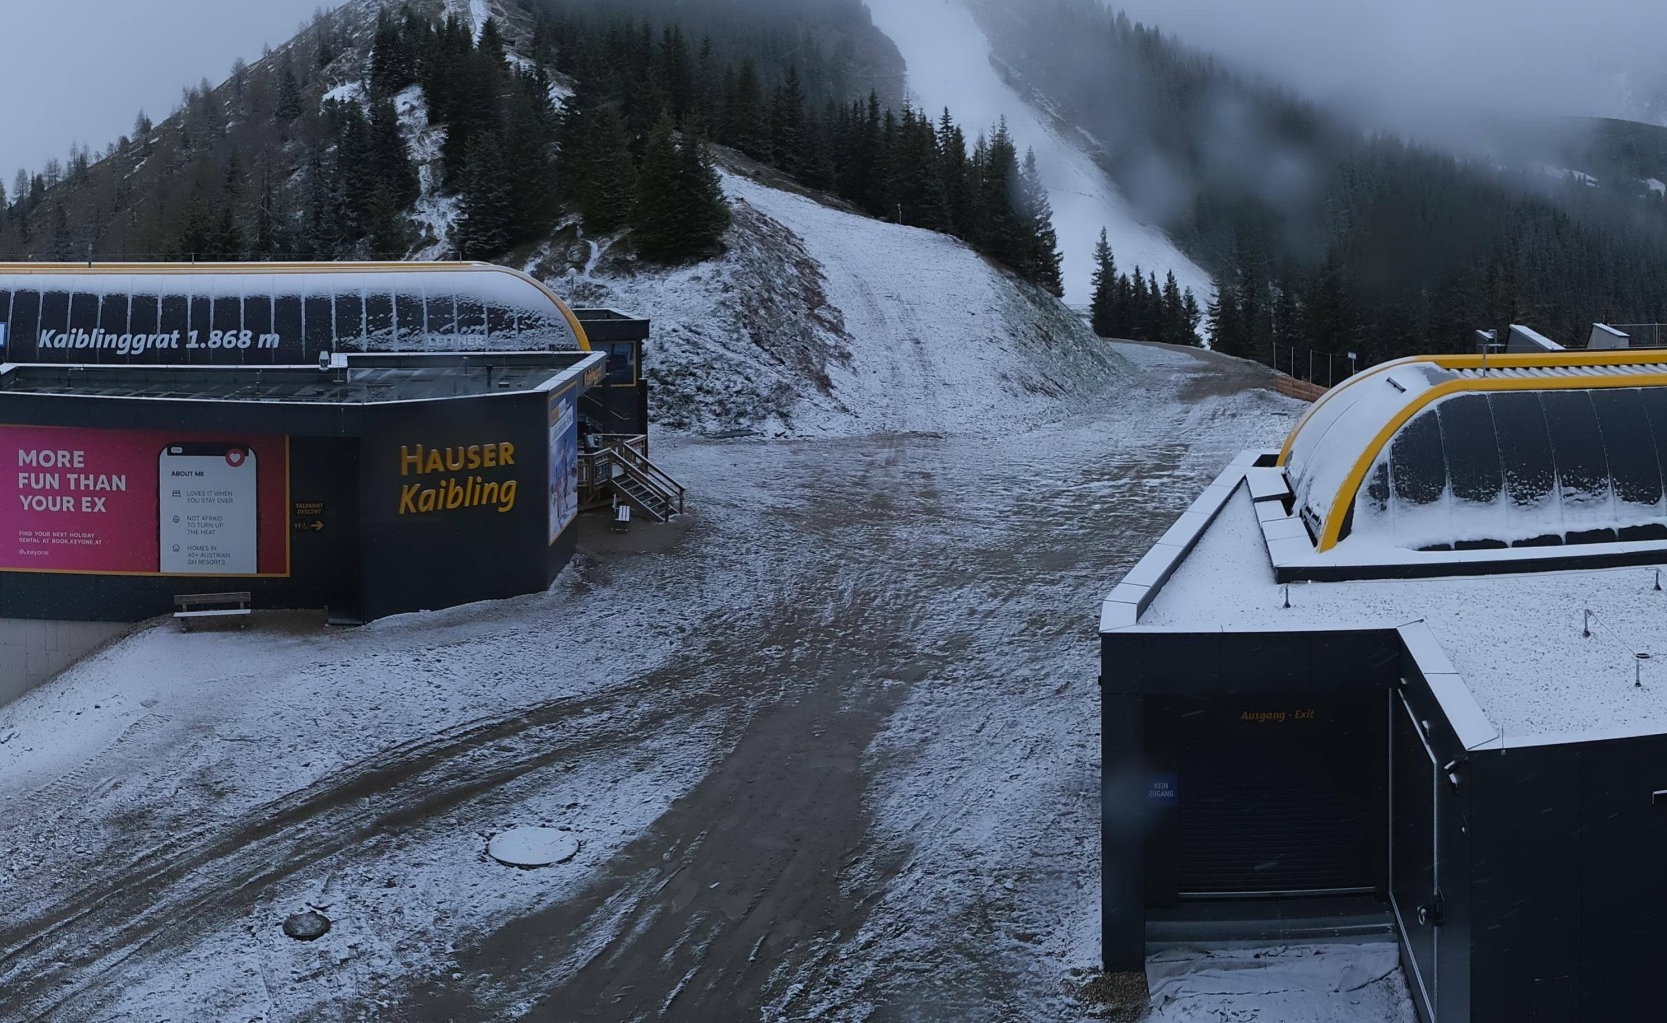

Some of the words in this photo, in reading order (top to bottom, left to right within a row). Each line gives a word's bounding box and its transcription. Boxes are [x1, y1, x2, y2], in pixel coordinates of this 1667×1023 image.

[38, 329, 180, 355] Kaiblinggrat
[186, 330, 252, 349] 1.868
[257, 332, 280, 349] m
[427, 335, 486, 347] LEITNER
[18, 449, 85, 468] MORE
[401, 441, 515, 476] HAUSER
[18, 472, 60, 490] FUN
[66, 474, 127, 491] THAN
[19, 495, 75, 512] YOUR
[81, 497, 107, 513] EX
[399, 476, 518, 515] Kaibling
[1240, 710, 1286, 722] Ausgang
[1294, 709, 1315, 719] Exit
[1153, 782, 1169, 790] KEIN
